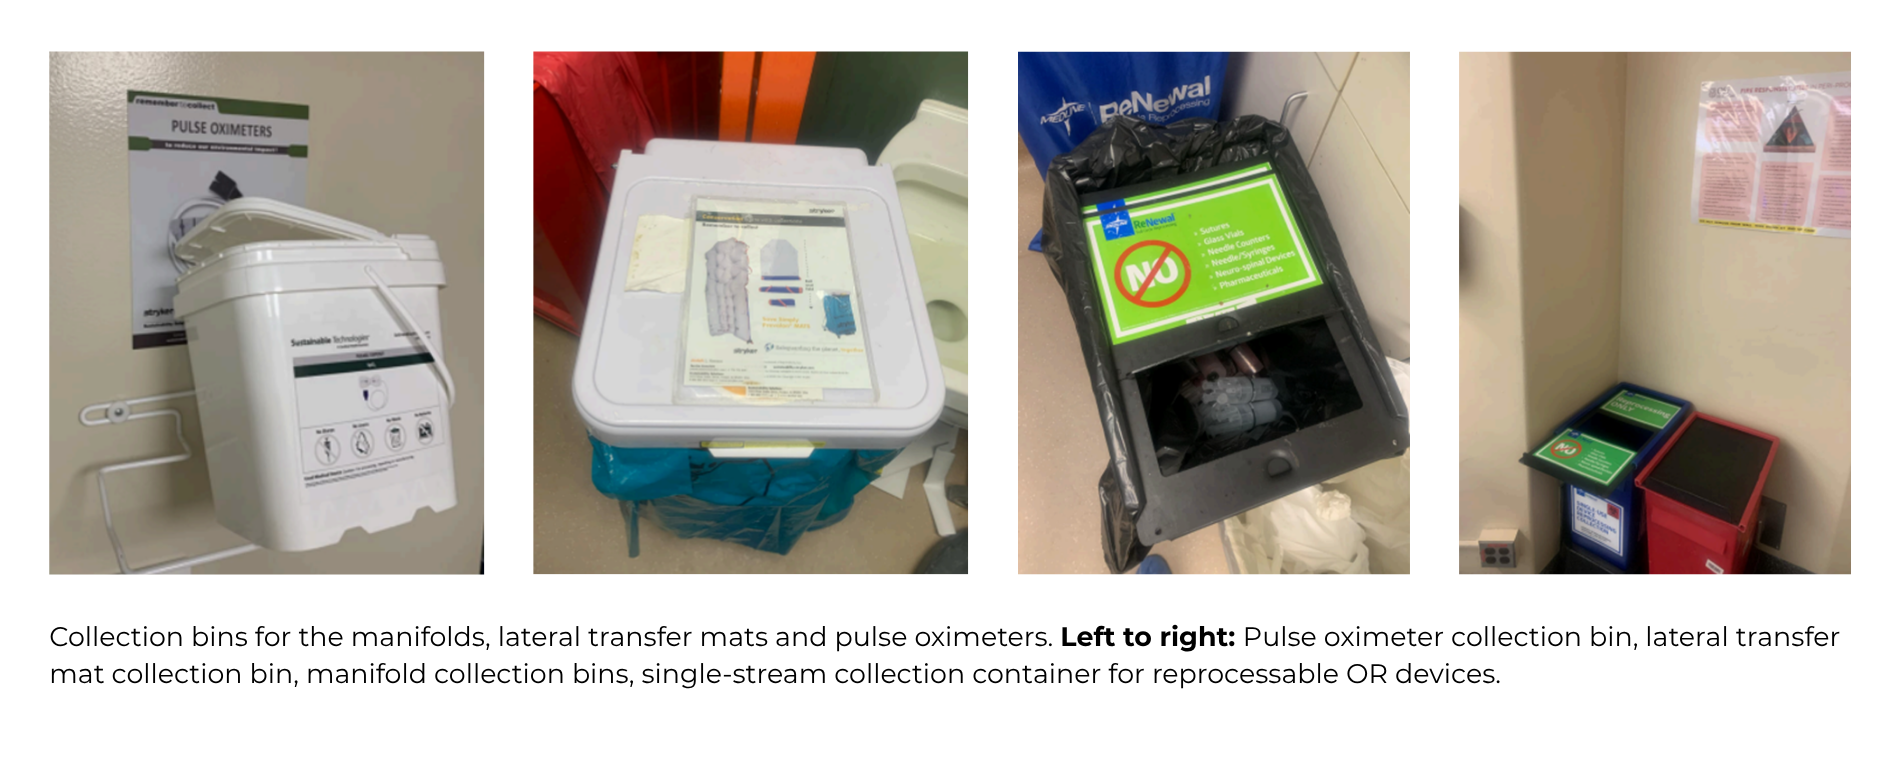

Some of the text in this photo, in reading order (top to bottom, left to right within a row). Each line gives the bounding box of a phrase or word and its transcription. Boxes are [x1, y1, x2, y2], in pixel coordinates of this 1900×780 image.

[1100, 75, 1211, 124] ReNewal
[1040, 103, 1086, 125] MEDLINE
[171, 119, 273, 138] PULSE OXIMETERS
[1134, 212, 1176, 230] ReNewal
[1199, 222, 1231, 236] Sutures
[1203, 229, 1245, 246] Glass Vials
[1207, 233, 1271, 256] Needle Counters
[1211, 244, 1276, 267] Needle/Syringes
[1215, 250, 1296, 278] Neuro-spinal Devices
[1125, 255, 1180, 293] NO
[1219, 265, 1284, 289] Pharmaceuticals
[291, 337, 332, 347] Sustainable
[1610, 401, 1636, 413] ONLY
[1616, 395, 1671, 420] Reprocessing
